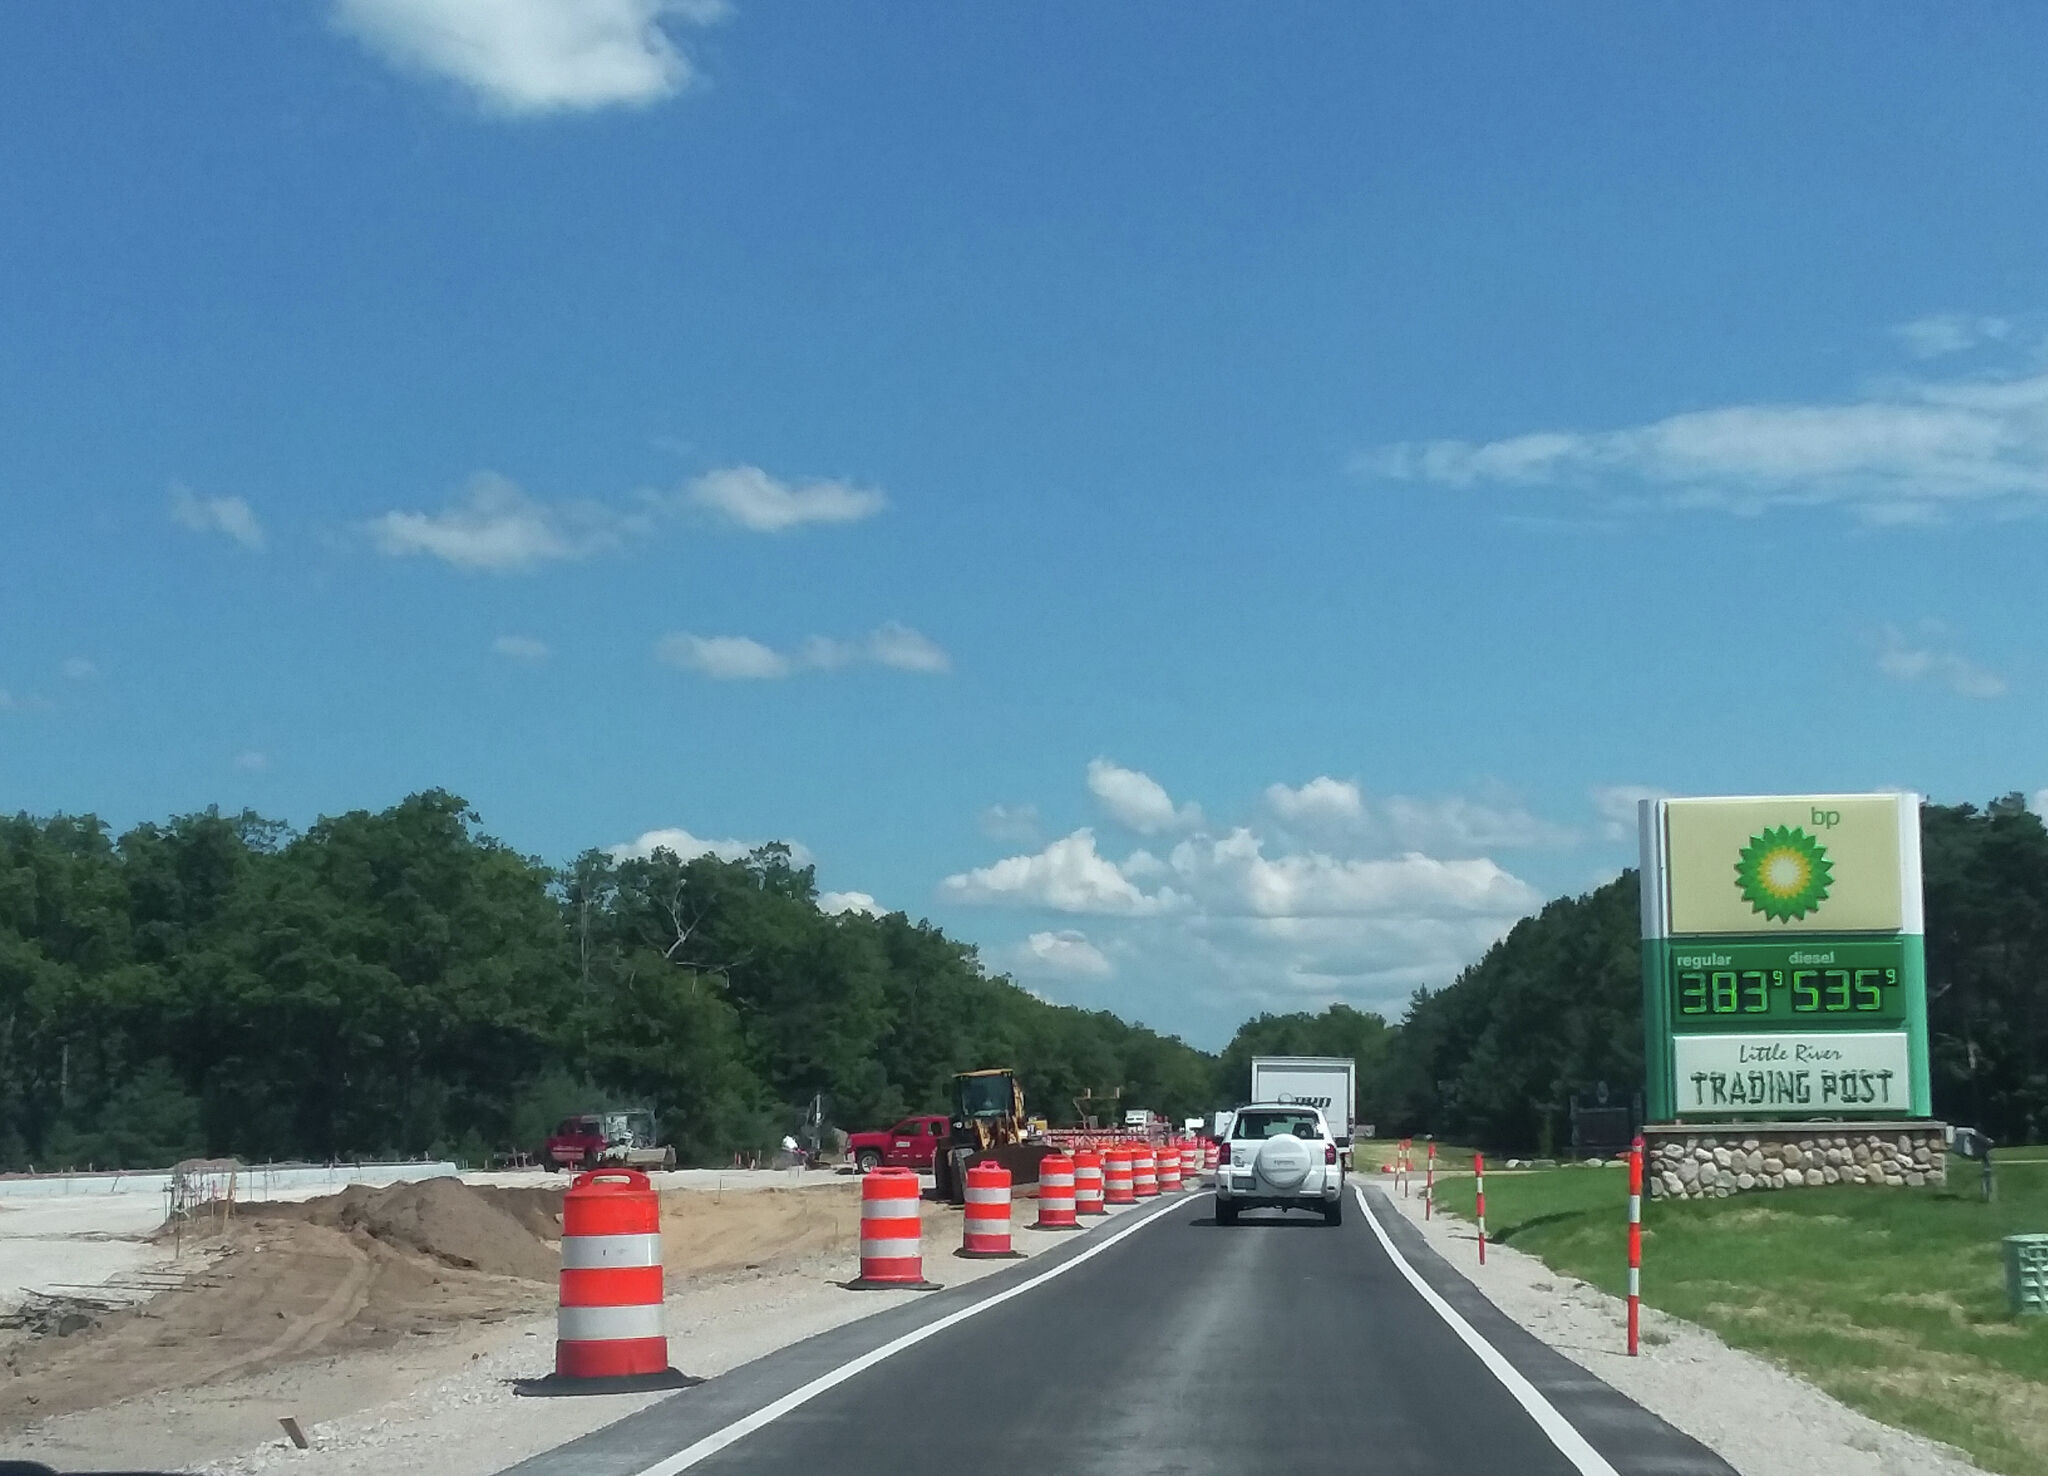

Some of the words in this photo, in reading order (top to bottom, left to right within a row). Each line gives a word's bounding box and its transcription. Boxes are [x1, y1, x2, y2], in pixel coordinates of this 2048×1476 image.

[1811, 806, 1840, 830] bp
[1677, 953, 1732, 969] regular
[1788, 951, 1835, 965] diesel
[1739, 1043, 1789, 1064] Little
[1796, 1043, 1843, 1064] River
[1690, 1069, 1810, 1105] TRADING
[1820, 1068, 1894, 1104] POST
